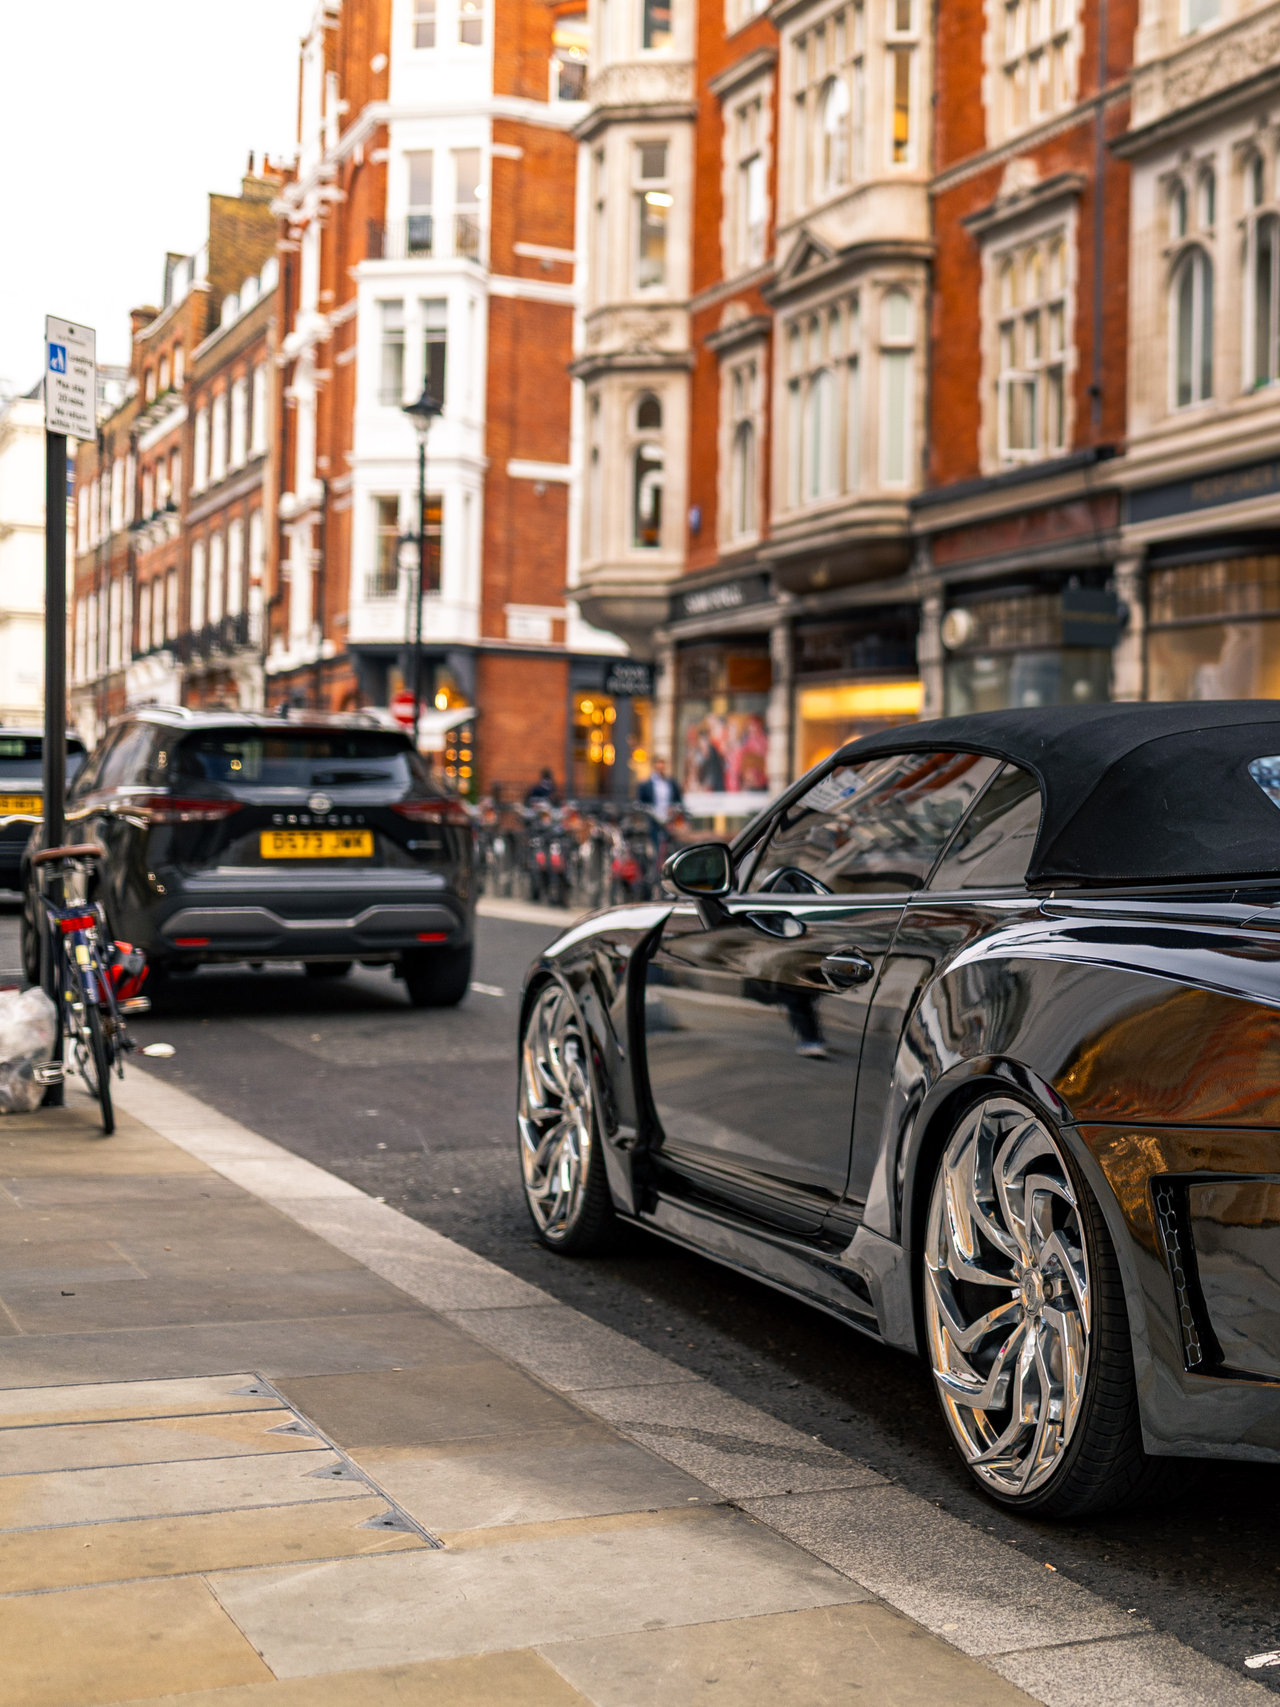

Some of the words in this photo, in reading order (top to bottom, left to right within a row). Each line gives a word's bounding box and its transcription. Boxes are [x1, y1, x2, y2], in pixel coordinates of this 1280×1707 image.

[67, 351, 93, 368] Loading
[73, 366, 88, 377] only
[56, 378, 69, 390] Max
[55, 405, 65, 416] No
[67, 410, 87, 421] return
